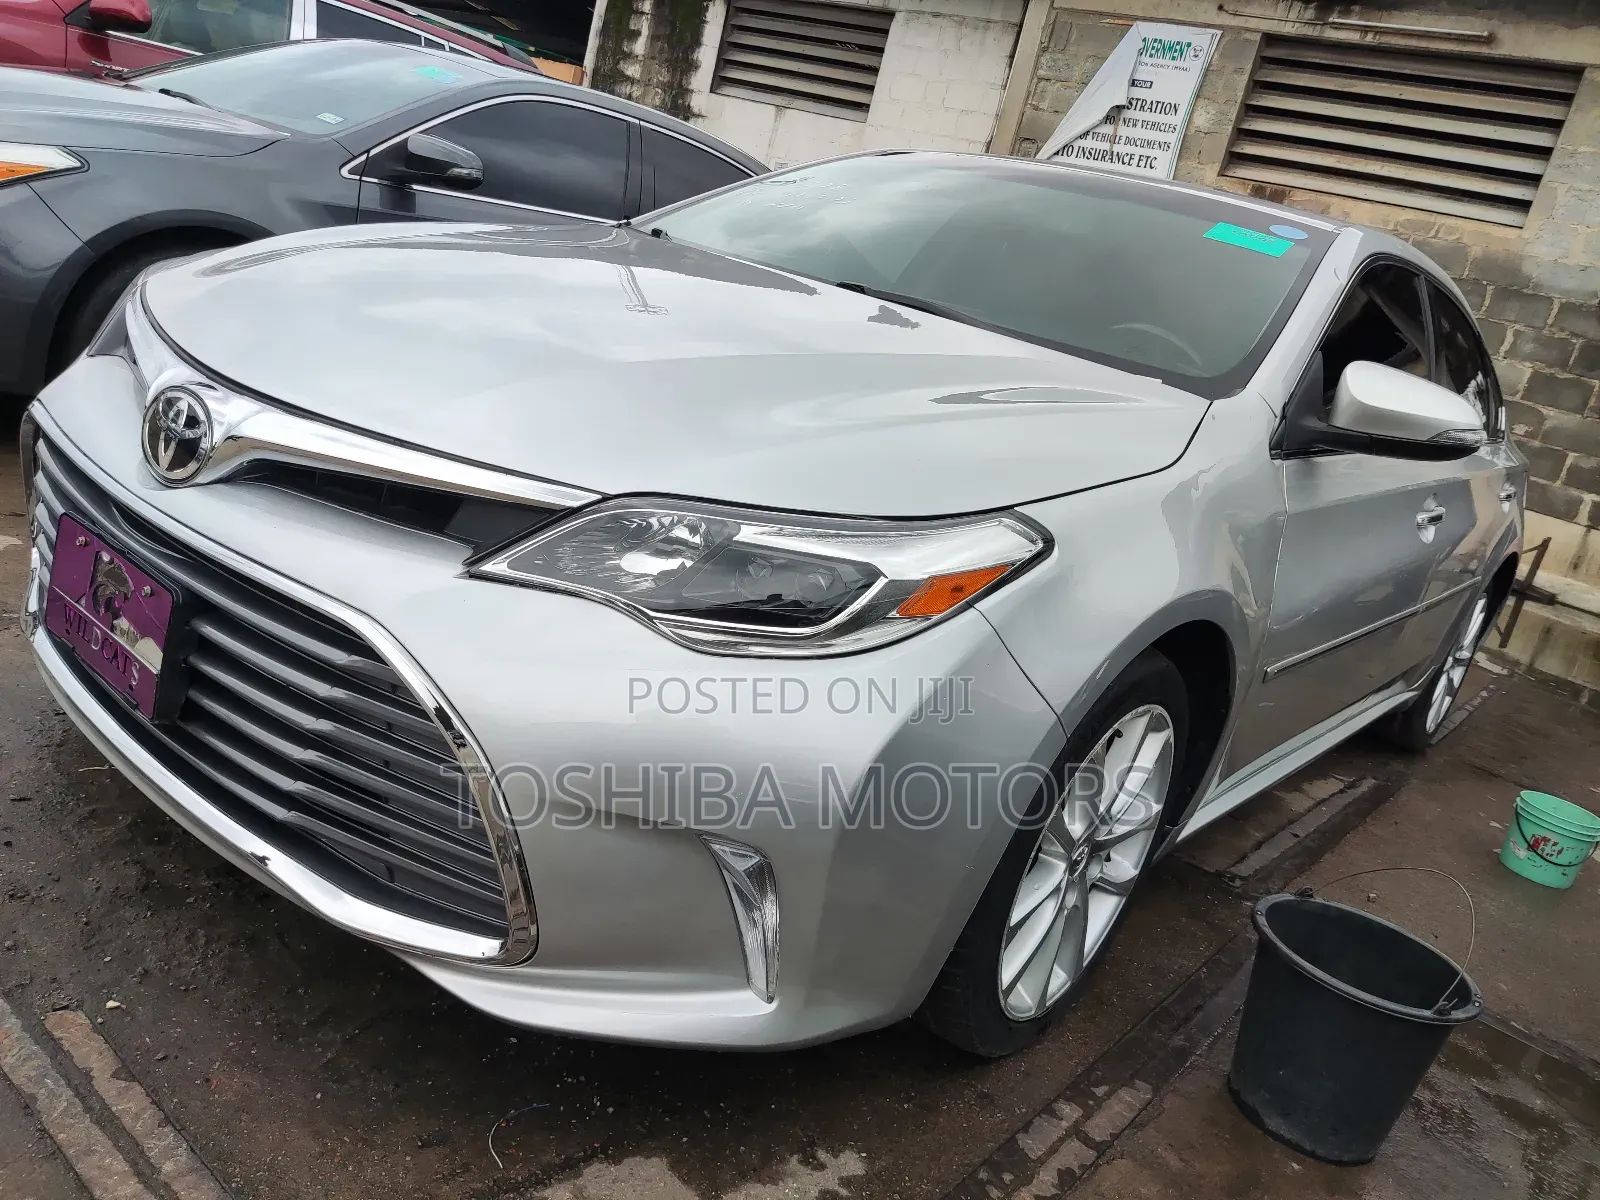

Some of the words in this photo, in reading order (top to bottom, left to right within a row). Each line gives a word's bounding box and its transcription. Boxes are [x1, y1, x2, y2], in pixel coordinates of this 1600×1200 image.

[1134, 80, 1151, 88] YOUR
[1120, 116, 1140, 129] NEW
[1140, 119, 1178, 134] VEHICLES
[1123, 135, 1172, 153] DOCUMENTS
[1075, 145, 1136, 167] INSURANCE
[1136, 153, 1158, 171] ETC.
[63, 602, 141, 686] WILDCATS
